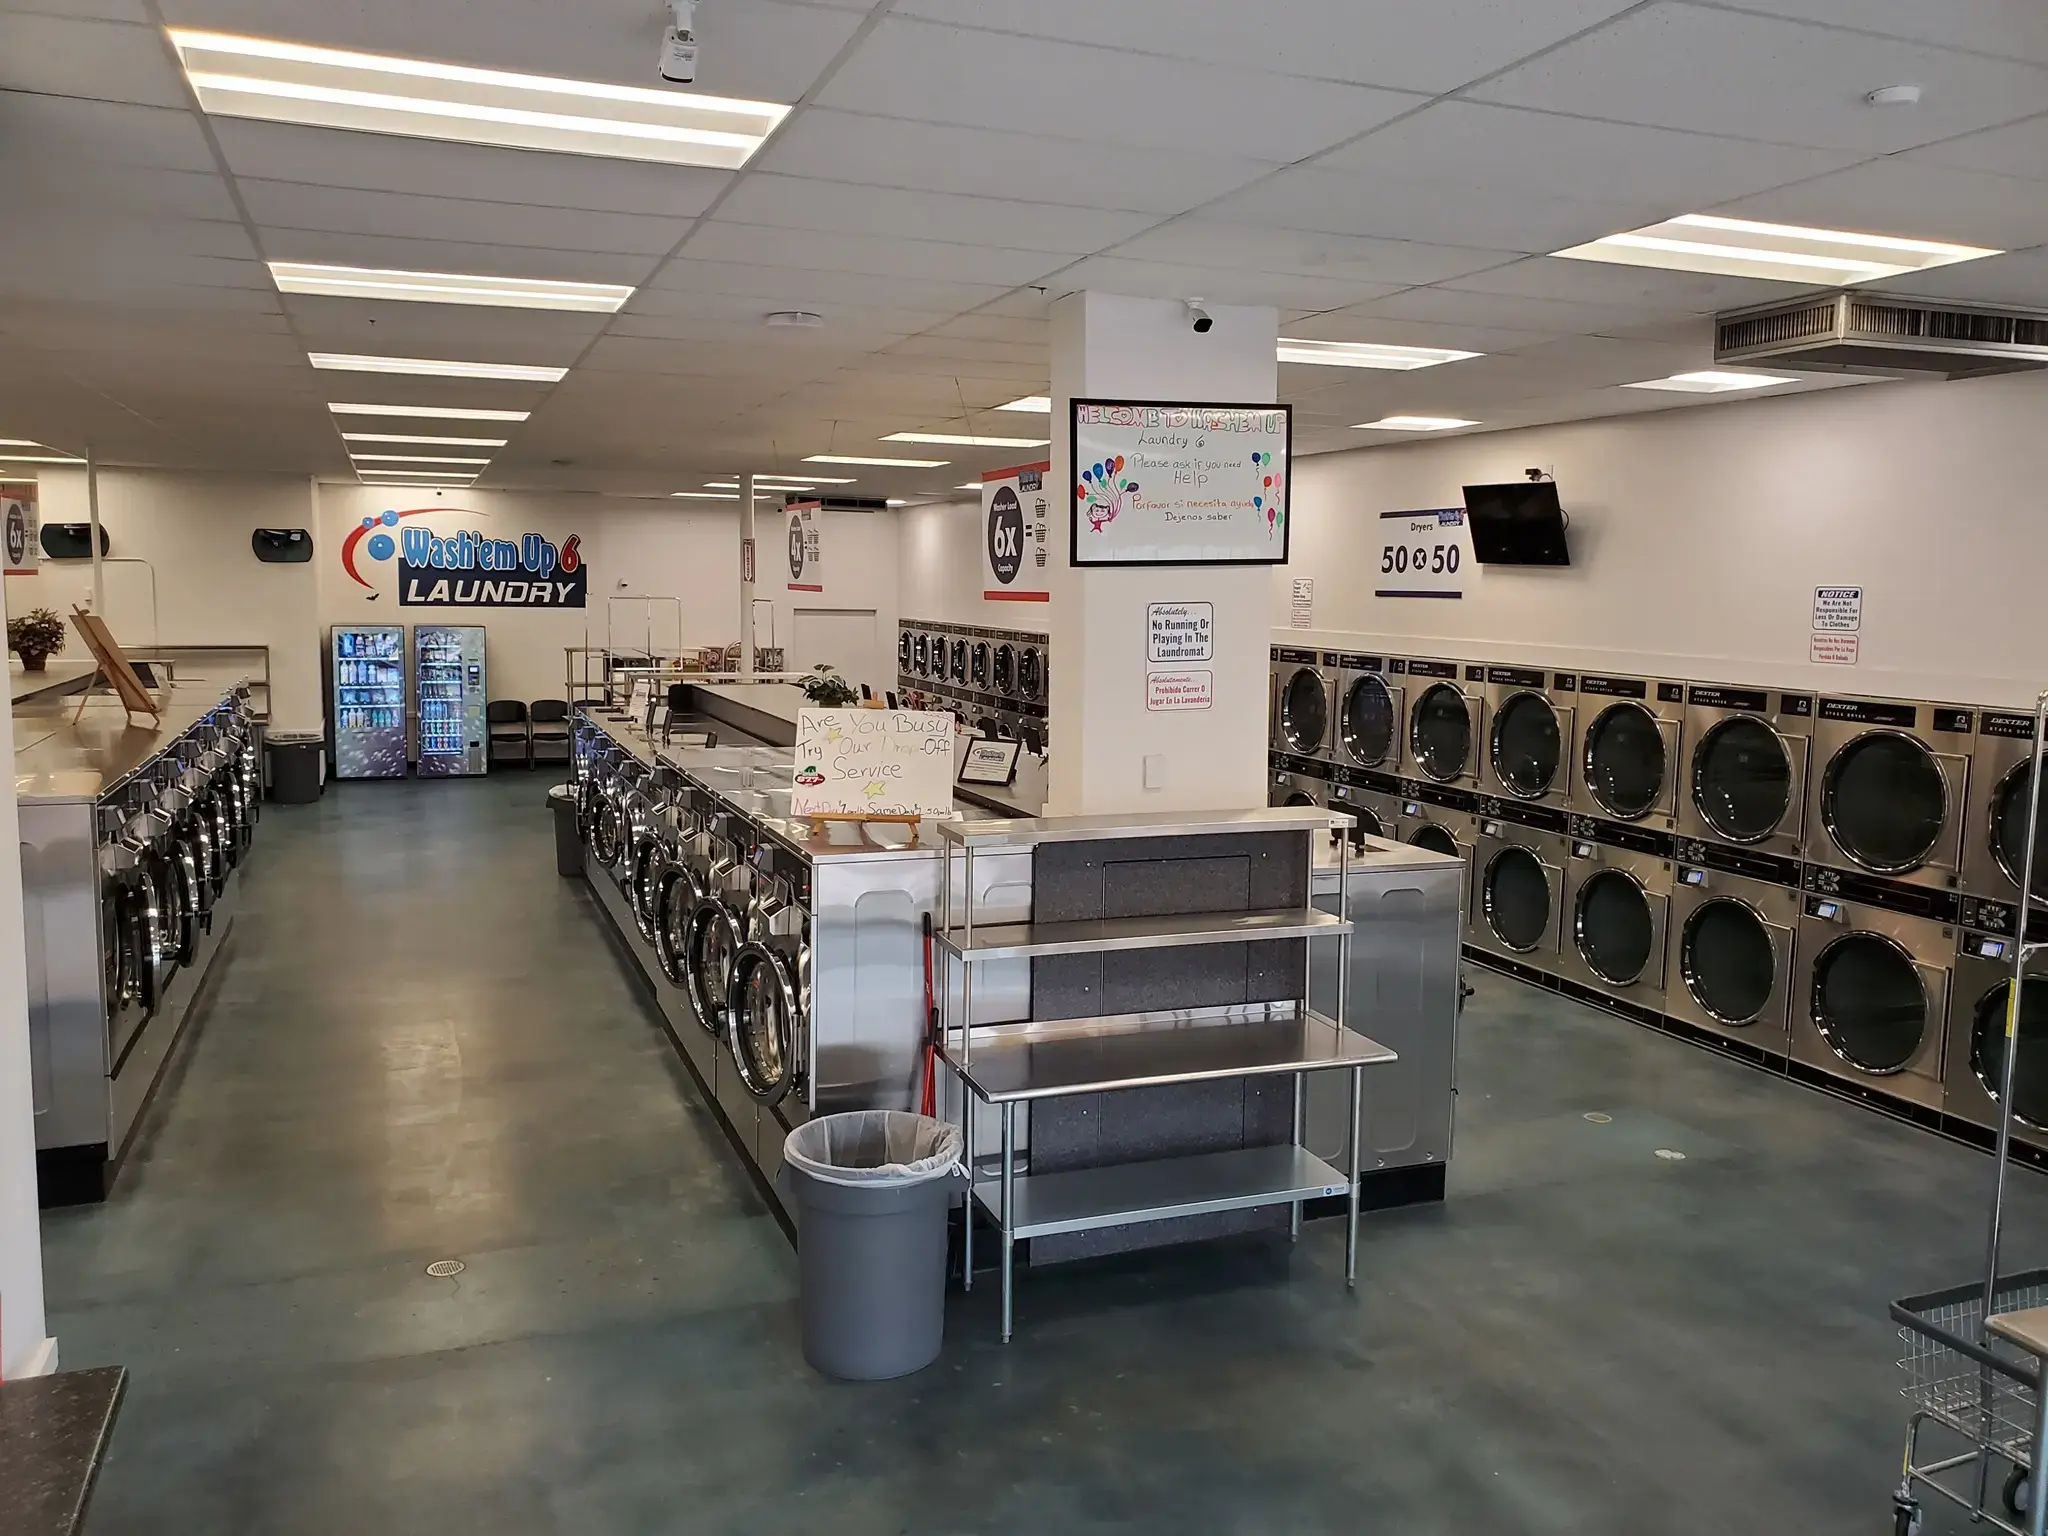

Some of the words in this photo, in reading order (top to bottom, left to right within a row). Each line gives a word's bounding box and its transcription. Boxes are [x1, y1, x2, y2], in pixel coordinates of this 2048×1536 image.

[1160, 407, 1189, 428] TO
[1265, 413, 1287, 434] UP
[1138, 431, 1188, 449] Laundry
[1195, 435, 1205, 448] 6
[1130, 452, 1169, 468] Please
[1172, 460, 1191, 469] ask
[1194, 458, 1202, 470] if
[1204, 460, 1221, 471] you
[1174, 470, 1208, 488] Help
[1132, 494, 1170, 510] Porfavor
[1174, 500, 1184, 508] si
[1187, 498, 1227, 508] necesita
[1165, 511, 1203, 524] Dejenos
[1207, 512, 1233, 521] saber
[10, 521, 23, 549] 6x
[1410, 522, 1434, 533] Dryers
[994, 516, 1018, 558] 6x
[401, 527, 518, 570] Wash'em
[522, 533, 556, 578] Up
[560, 534, 581, 573] 6
[1381, 545, 1408, 574] 50
[1431, 544, 1460, 574] 50
[407, 579, 577, 604] LAUNDRY
[1152, 620, 1163, 631] No
[1165, 619, 1198, 632] Running
[1200, 618, 1210, 630] Or
[1836, 614, 1858, 622] Damage
[1152, 633, 1183, 646] Playing
[1184, 632, 1193, 643] In
[1195, 632, 1209, 643] The
[1157, 646, 1205, 658] Laundromat
[1155, 685, 1182, 694] Prohibido
[1150, 697, 1165, 706] Jugar
[1166, 696, 1173, 704] En
[1174, 696, 1180, 704] La
[1826, 703, 1858, 711] DEXTER
[801, 714, 840, 736] Are
[849, 712, 887, 735] You
[892, 713, 949, 738] Busy
[1990, 717, 2030, 727] DEXTER
[797, 739, 823, 761] Try
[839, 737, 872, 755] Our
[832, 756, 903, 780] Service
